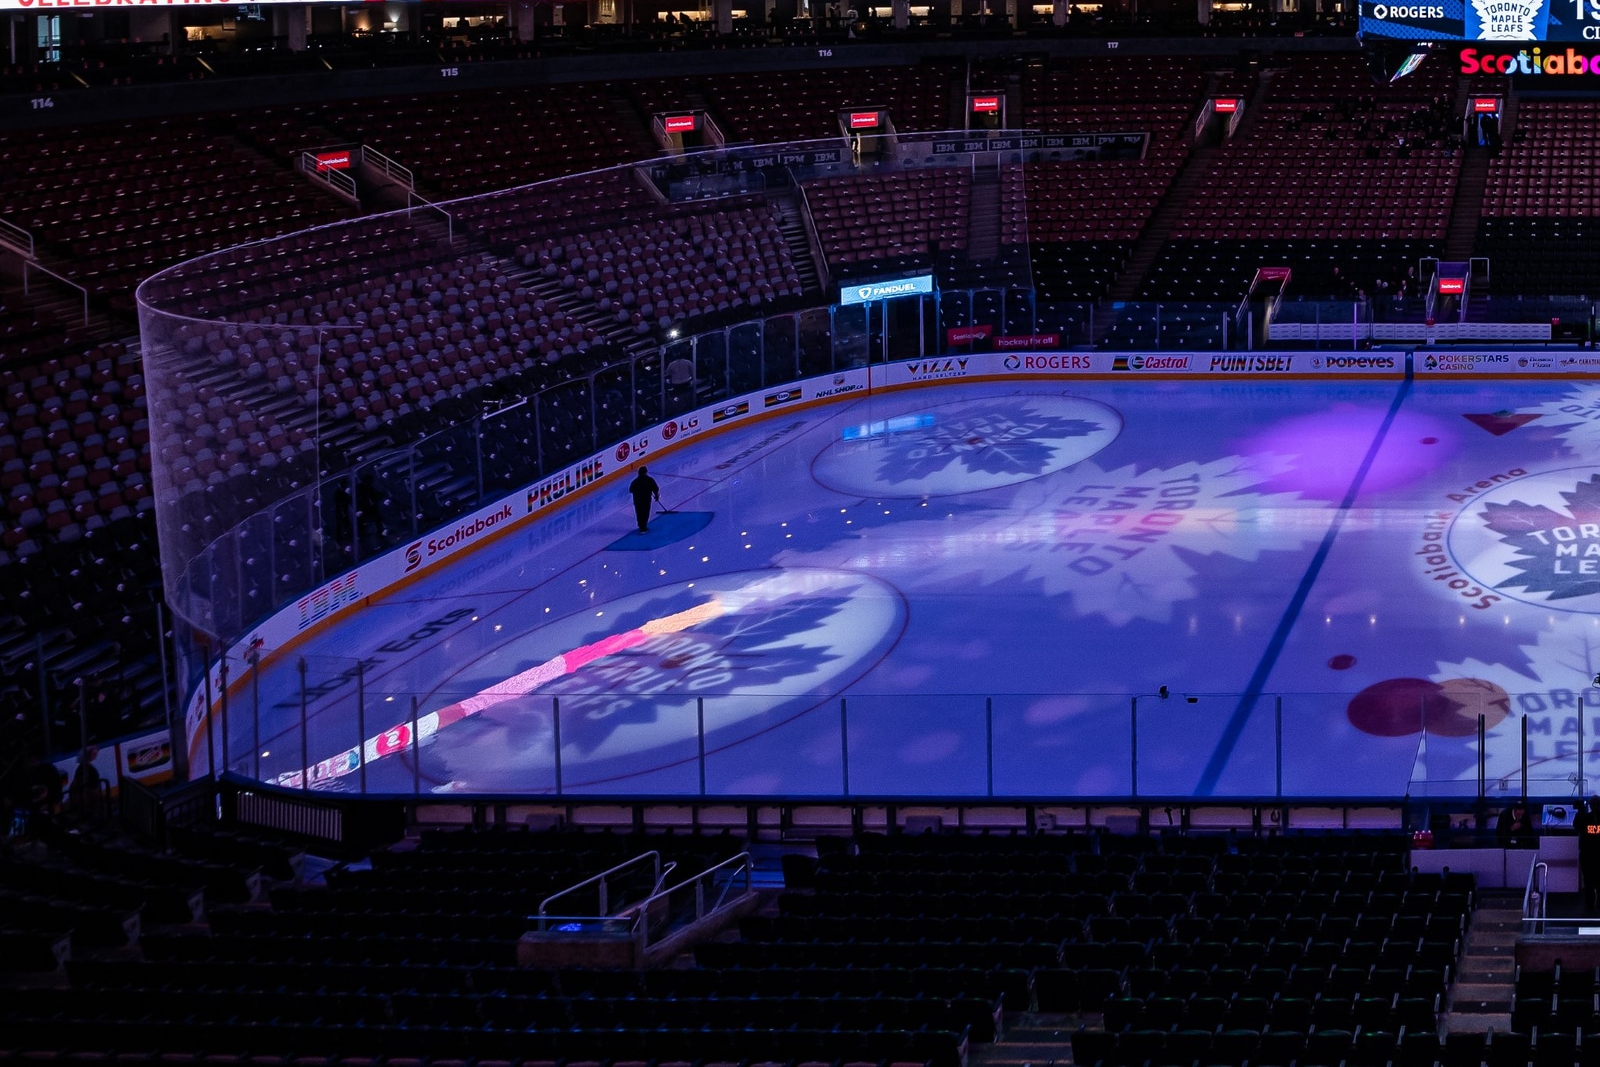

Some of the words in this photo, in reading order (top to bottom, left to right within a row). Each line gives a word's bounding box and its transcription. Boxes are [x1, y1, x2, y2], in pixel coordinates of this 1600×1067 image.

[1390, 5, 1444, 18] ROGERS
[1484, 0, 1532, 16] TORONTO
[1491, 14, 1523, 23] MAPLE
[1491, 23, 1523, 33] LEAFS
[818, 49, 832, 57] 116
[441, 67, 458, 77] 115
[30, 97, 54, 109] 114
[936, 143, 956, 152] IBM
[964, 142, 984, 151] IBM
[992, 140, 1011, 149] IBM
[1046, 138, 1064, 146] IBM
[815, 153, 835, 162] IBM
[873, 283, 916, 296] FANDUEL
[998, 338, 1028, 349] hockey
[1025, 356, 1091, 369] ROGERS
[1145, 355, 1189, 370] Castrol
[1209, 355, 1295, 373] POINTSBET
[1438, 354, 1509, 363] POKERSTARS
[906, 358, 969, 375] VIZZY
[680, 416, 698, 432] LG
[632, 438, 648, 454] LG
[527, 455, 604, 513] PROLINE
[1446, 466, 1528, 502] Arena
[427, 503, 514, 557] Scotiabank
[298, 572, 364, 631] IBM
